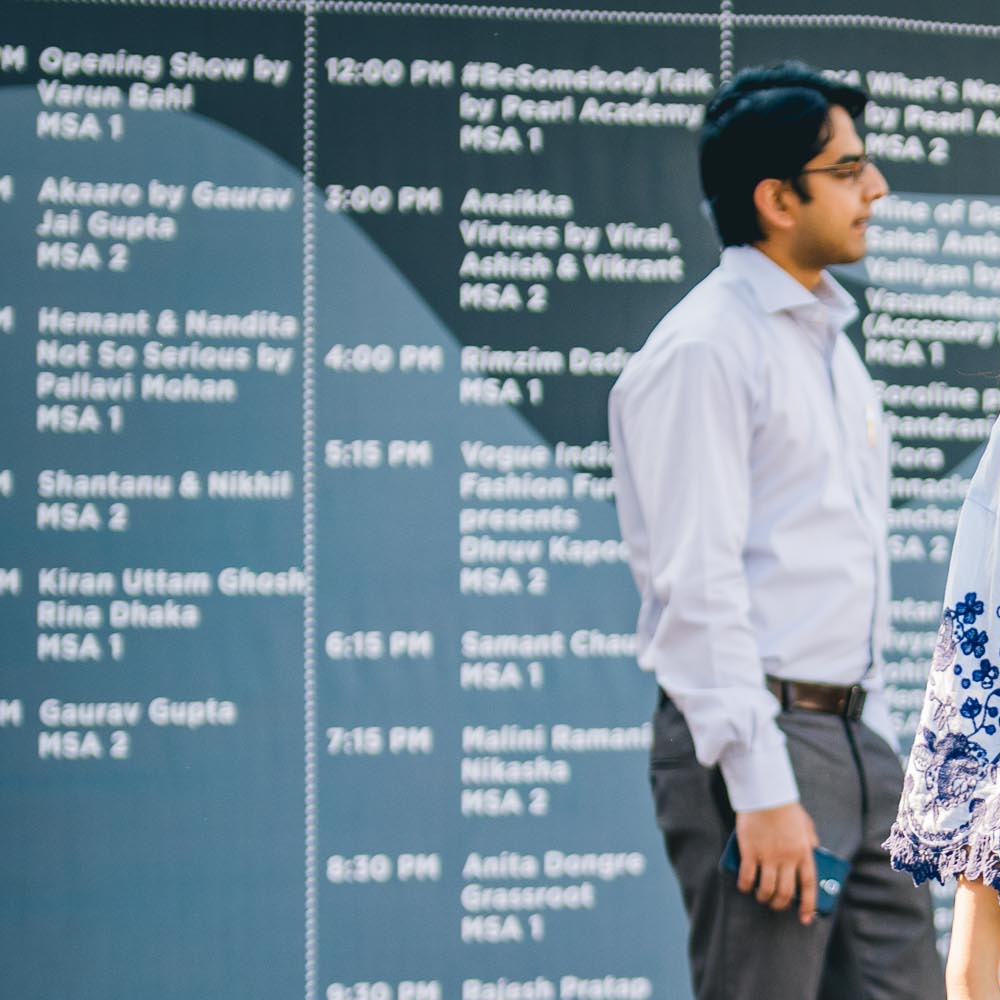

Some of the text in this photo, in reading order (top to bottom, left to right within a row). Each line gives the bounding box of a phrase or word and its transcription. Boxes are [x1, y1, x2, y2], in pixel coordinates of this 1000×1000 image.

[39, 47, 291, 85] Opening Show by
[326, 57, 455, 88] 12:00 PM
[37, 79, 123, 108] Varun
[37, 112, 125, 141] MSA 1
[459, 92, 707, 131] by Pearl Academy
[865, 100, 900, 131] by
[904, 104, 974, 135] Pearl
[459, 124, 544, 155] MSA 1
[865, 133, 949, 165] MSA 2
[38, 176, 142, 207] Akaaro
[148, 179, 186, 210] by
[191, 181, 294, 211] Gaurav
[325, 185, 442, 215] 3:00 PM
[37, 208, 178, 242] Jai Gupta
[459, 219, 560, 250] Virtues
[564, 221, 600, 253] by
[37, 242, 130, 272] MSA 2
[459, 251, 686, 284] Ashish & Vikrant
[459, 283, 548, 313] MSA 2
[38, 307, 150, 338] Hemant
[156, 309, 180, 338] &
[186, 310, 299, 340] Nandita
[37, 340, 295, 375] Not So Serious by
[325, 343, 444, 373] 4:00 PM
[460, 344, 565, 375] Rimzim
[865, 339, 945, 369] MSA 1
[37, 372, 237, 402] Pallavi Mohan
[459, 377, 544, 406] MSA 1
[873, 380, 979, 409] oroline
[37, 404, 125, 433] MSA 1
[325, 440, 433, 469] 5:15 PM
[461, 441, 549, 473] Vogue
[38, 470, 175, 499] Shantanu
[179, 471, 201, 499] &
[208, 470, 293, 500] Nikhil
[460, 472, 568, 501] Fashion
[37, 503, 130, 532] MSA 2
[460, 535, 544, 564] Dhruv
[38, 567, 308, 597] Kiran Uttam Ghosh
[460, 567, 548, 596] MSA 2
[37, 599, 200, 629] Rina Dhaka
[37, 632, 125, 662] MSA 1
[325, 631, 434, 660] 6:15 PM
[461, 630, 566, 659] Samant
[461, 661, 544, 690] MSA 1
[39, 697, 238, 730] Gaurav Gupta
[38, 730, 131, 760] MSA 2
[326, 726, 434, 756] 7:15 PM
[462, 721, 654, 754] Malini Ramani
[461, 756, 571, 785] Nikasha
[461, 787, 549, 817] MSA 2
[397, 853, 441, 883] PM
[462, 850, 648, 881] Anita Dongre
[461, 882, 596, 911] Grassroot
[461, 913, 544, 943] MSA 1
